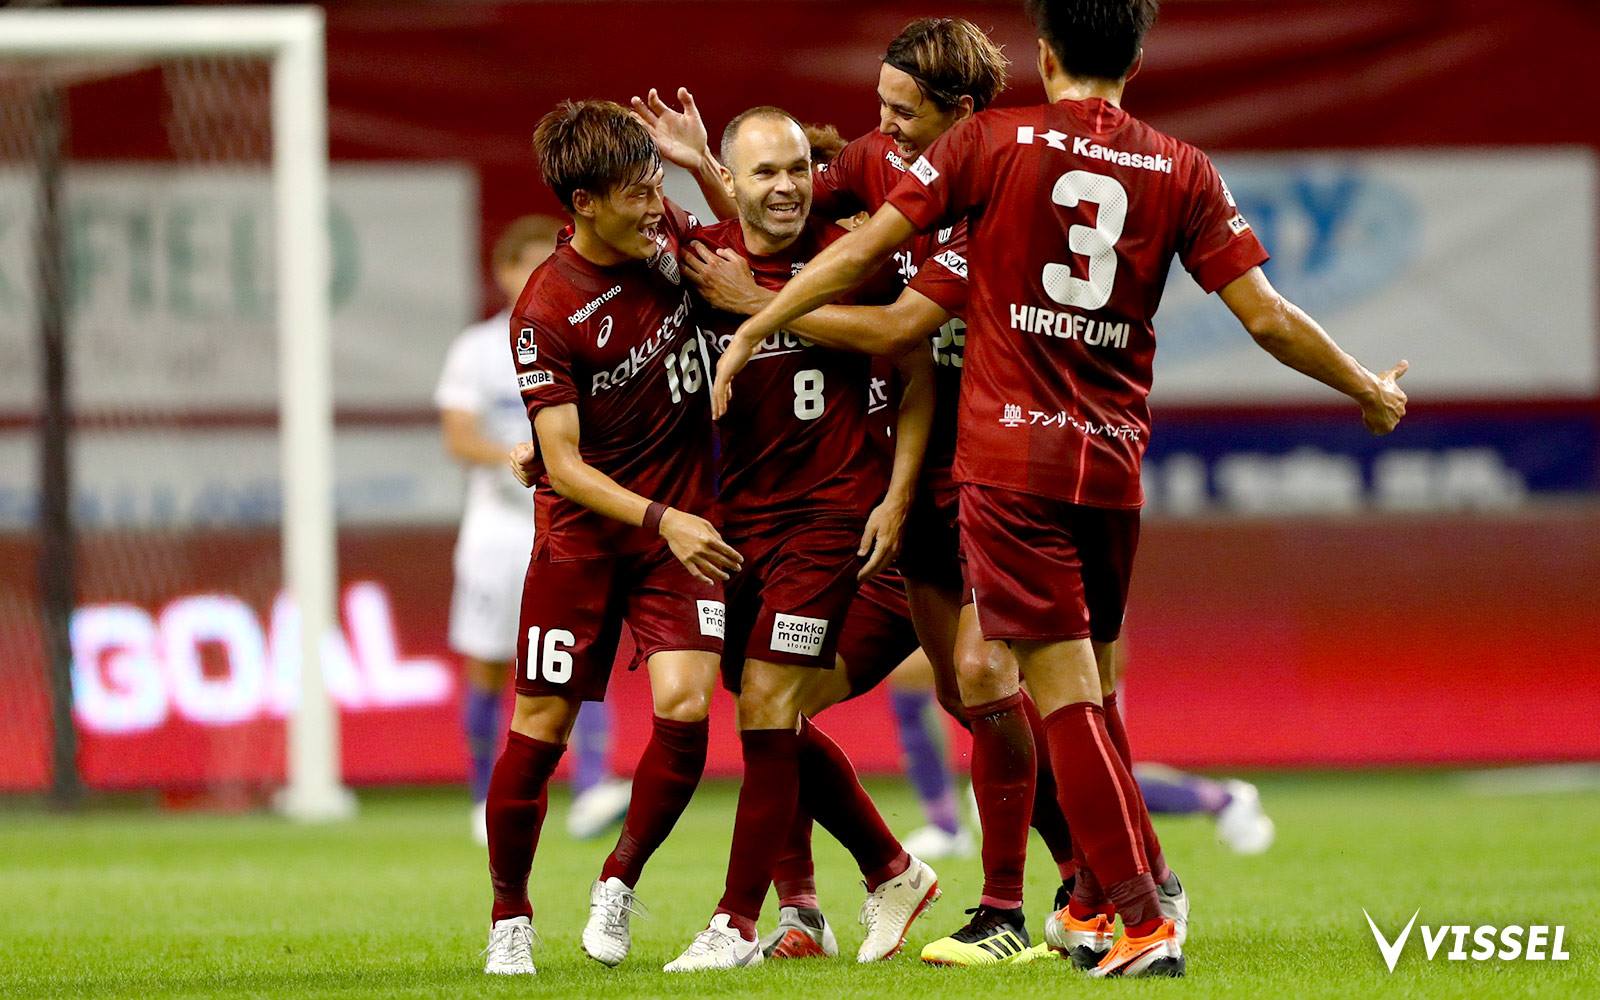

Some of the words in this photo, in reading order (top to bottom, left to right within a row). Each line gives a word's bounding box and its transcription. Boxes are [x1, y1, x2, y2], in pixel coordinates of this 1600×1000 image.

[1072, 136, 1173, 174] Kawasaki
[1042, 170, 1128, 310] 3
[567, 296, 605, 326] Rakuten
[602, 285, 622, 301] toto
[1009, 304, 1130, 349] HIROFUMI
[591, 289, 693, 397] Rakuten
[525, 372, 551, 386] KOBE
[664, 338, 703, 404] 16
[793, 368, 825, 421] 8
[777, 620, 824, 635] e-zakka
[778, 631, 821, 645] mania
[527, 625, 576, 684] 16
